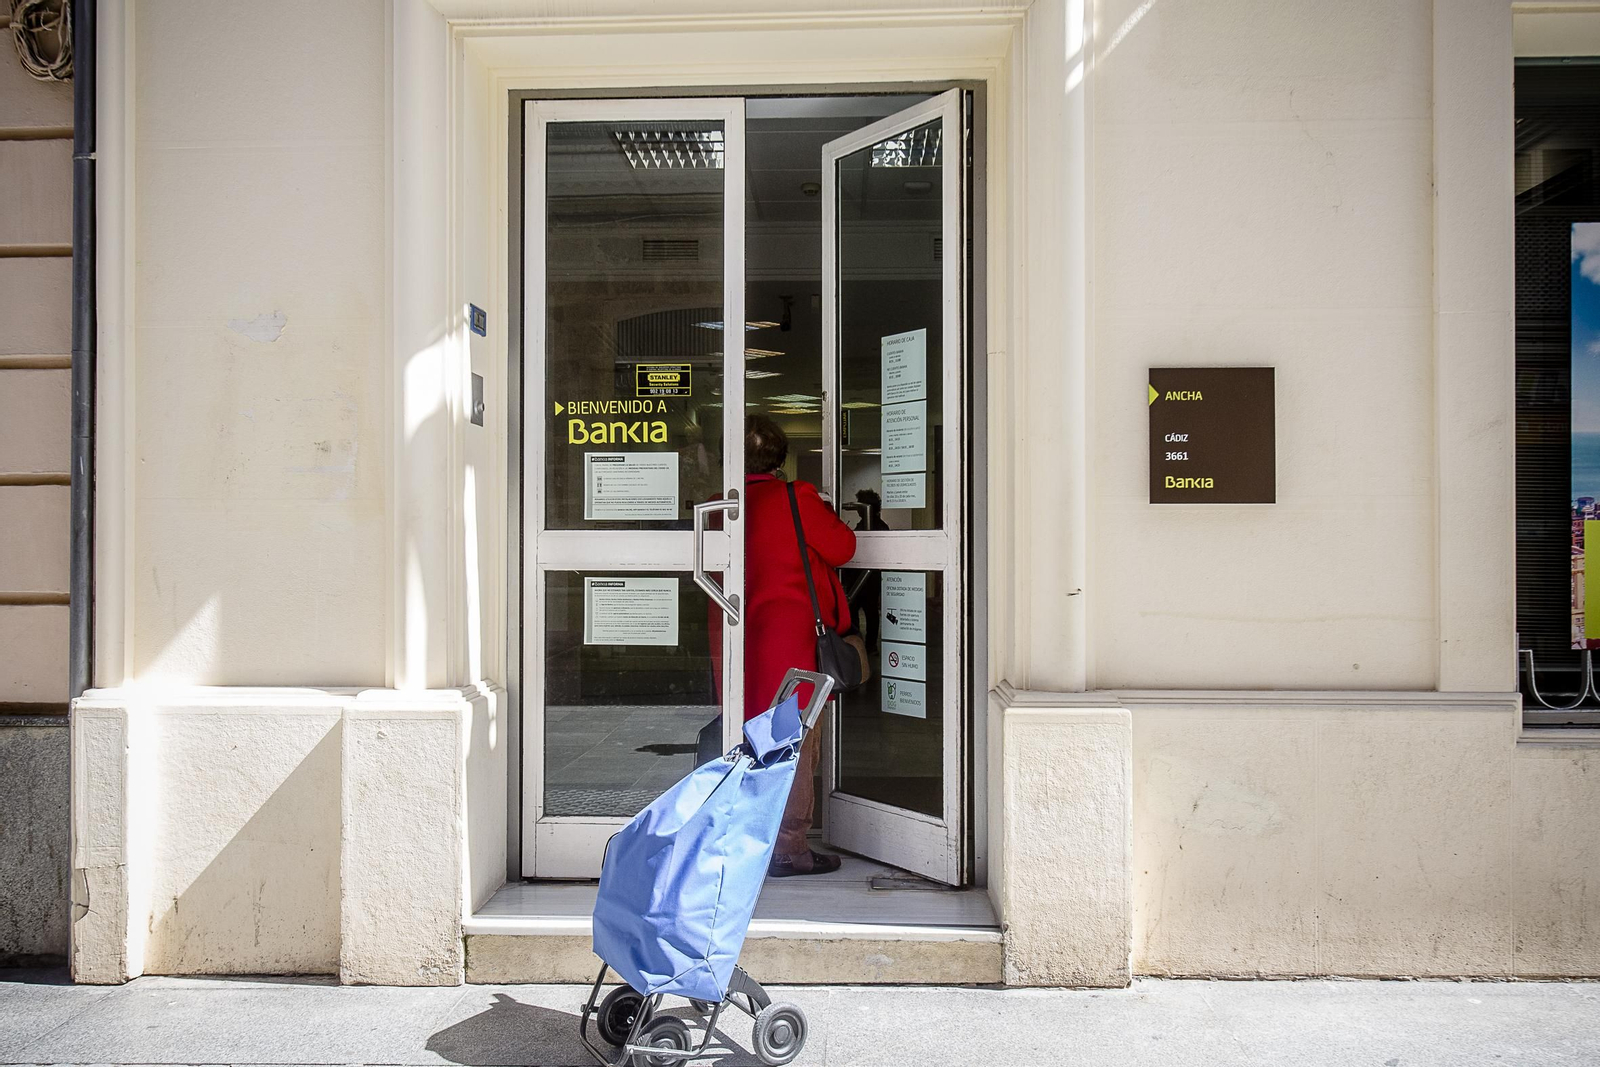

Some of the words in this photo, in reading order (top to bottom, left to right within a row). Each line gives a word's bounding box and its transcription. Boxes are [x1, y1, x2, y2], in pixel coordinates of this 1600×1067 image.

[887, 338, 901, 346] HORARIO
[1165, 391, 1203, 401] ANCHA
[568, 400, 653, 415] BIENVENIDO
[657, 399, 667, 413] A
[568, 419, 668, 445] Bankia
[1165, 432, 1189, 442] CÁDIZ
[1165, 452, 1189, 461] 3661
[1165, 476, 1214, 488] Bankia
